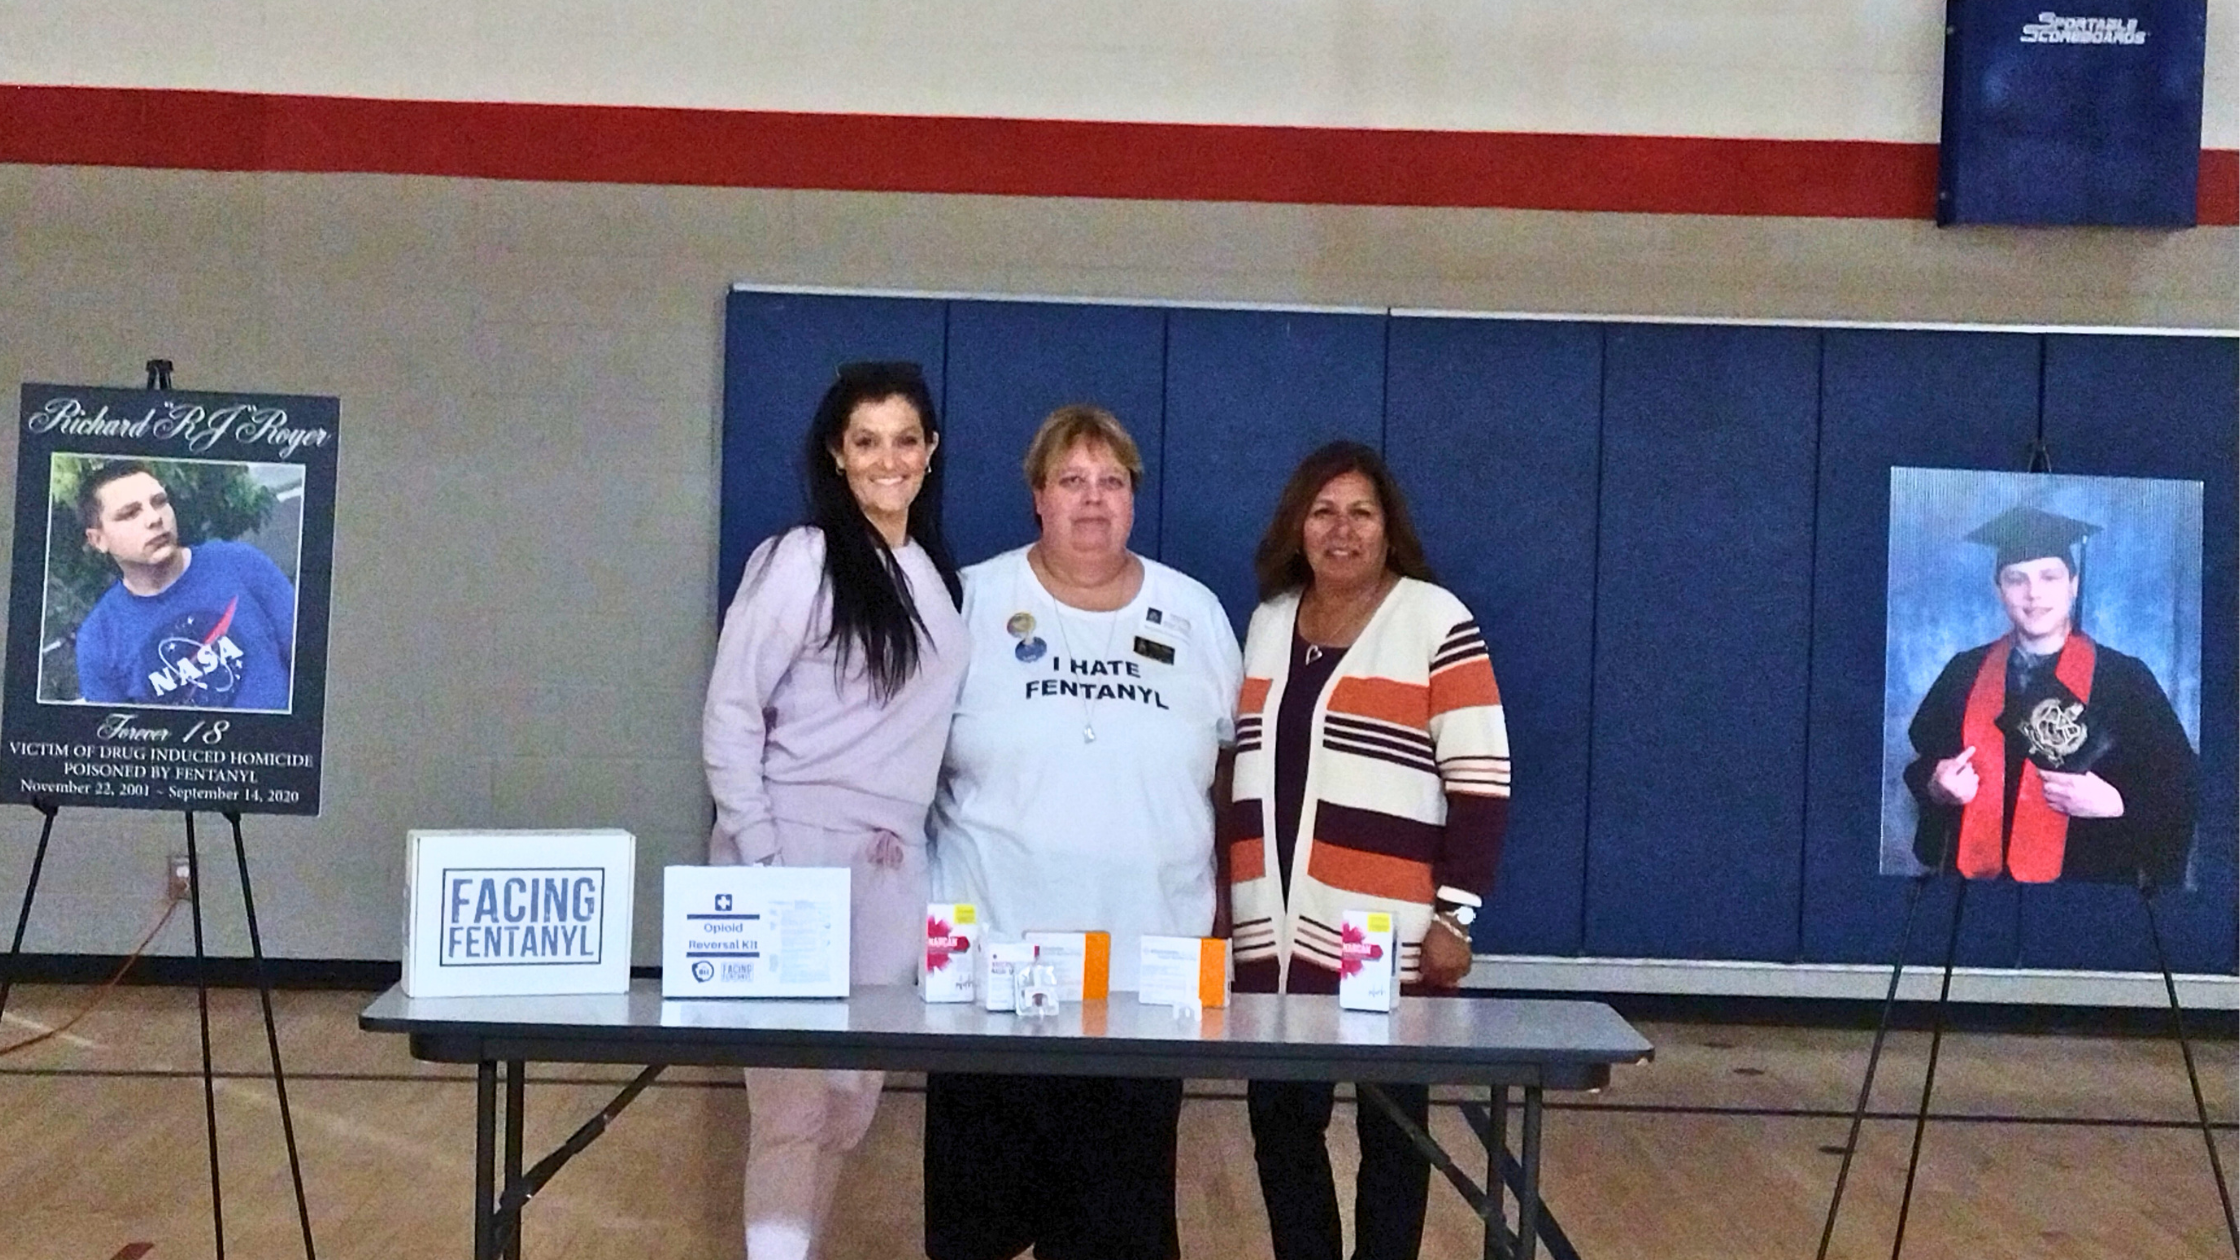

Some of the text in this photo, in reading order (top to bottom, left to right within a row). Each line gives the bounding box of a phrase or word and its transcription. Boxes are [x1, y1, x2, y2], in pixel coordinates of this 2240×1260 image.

[29, 398, 156, 438] Richard
[236, 407, 331, 458] Royer
[148, 635, 244, 696] NASA
[1053, 656, 1060, 671] I
[1070, 658, 1141, 678] HATE
[1026, 679, 1169, 710] FENTANYL
[97, 712, 230, 745] Forever 18
[10, 741, 314, 768] VICTIM OF DRUG INDUCED HOMICIDE
[64, 762, 258, 784] POISONED BY FENTANYL
[20, 778, 90, 794] November
[95, 782, 115, 797] 22,
[119, 783, 149, 797] 2001
[168, 785, 239, 802] September
[245, 788, 263, 803] 14,
[267, 789, 299, 803] 2020
[451, 876, 596, 923] FACING
[448, 925, 595, 958] FENTANYL
[703, 922, 744, 935] Opioid
[688, 939, 758, 950] Reversal Kit
